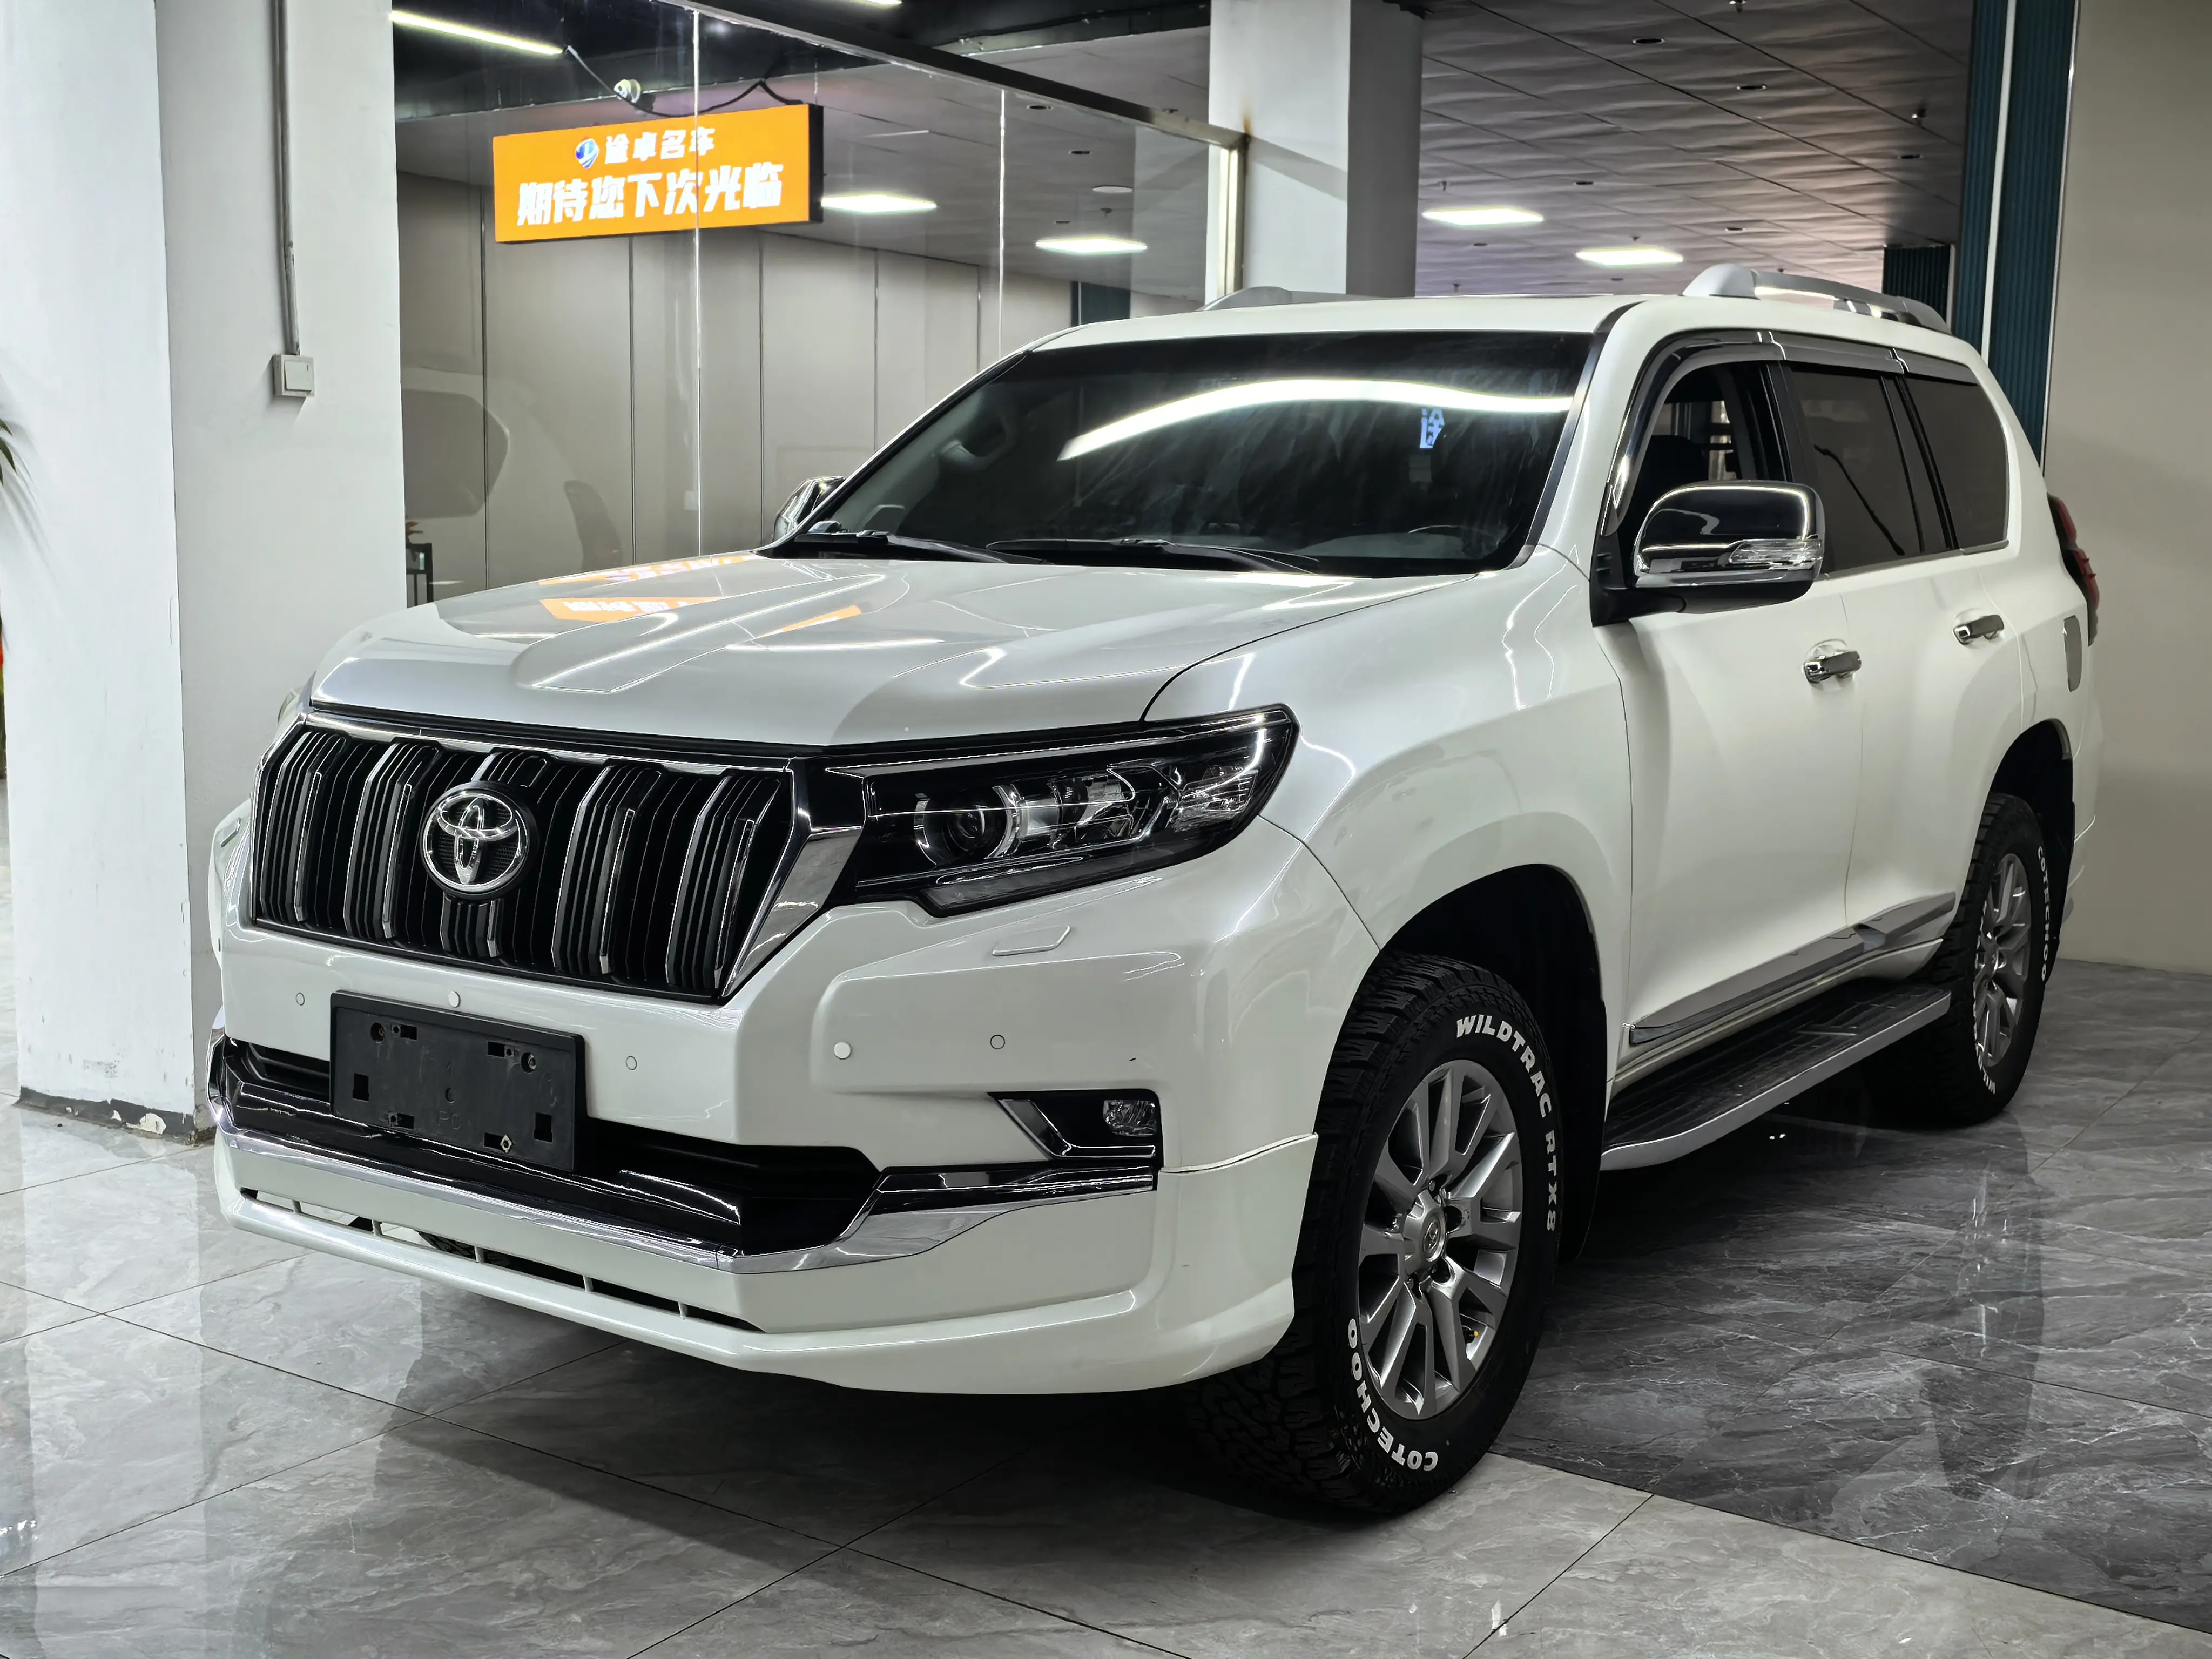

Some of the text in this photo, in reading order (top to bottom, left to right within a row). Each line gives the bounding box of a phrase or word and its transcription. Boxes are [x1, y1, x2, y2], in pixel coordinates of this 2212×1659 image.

[517, 161, 784, 226] 期待您下次光临
[1456, 1014, 1552, 1118] WILDTRAC
[1348, 1318, 1438, 1471] COTECHOO
